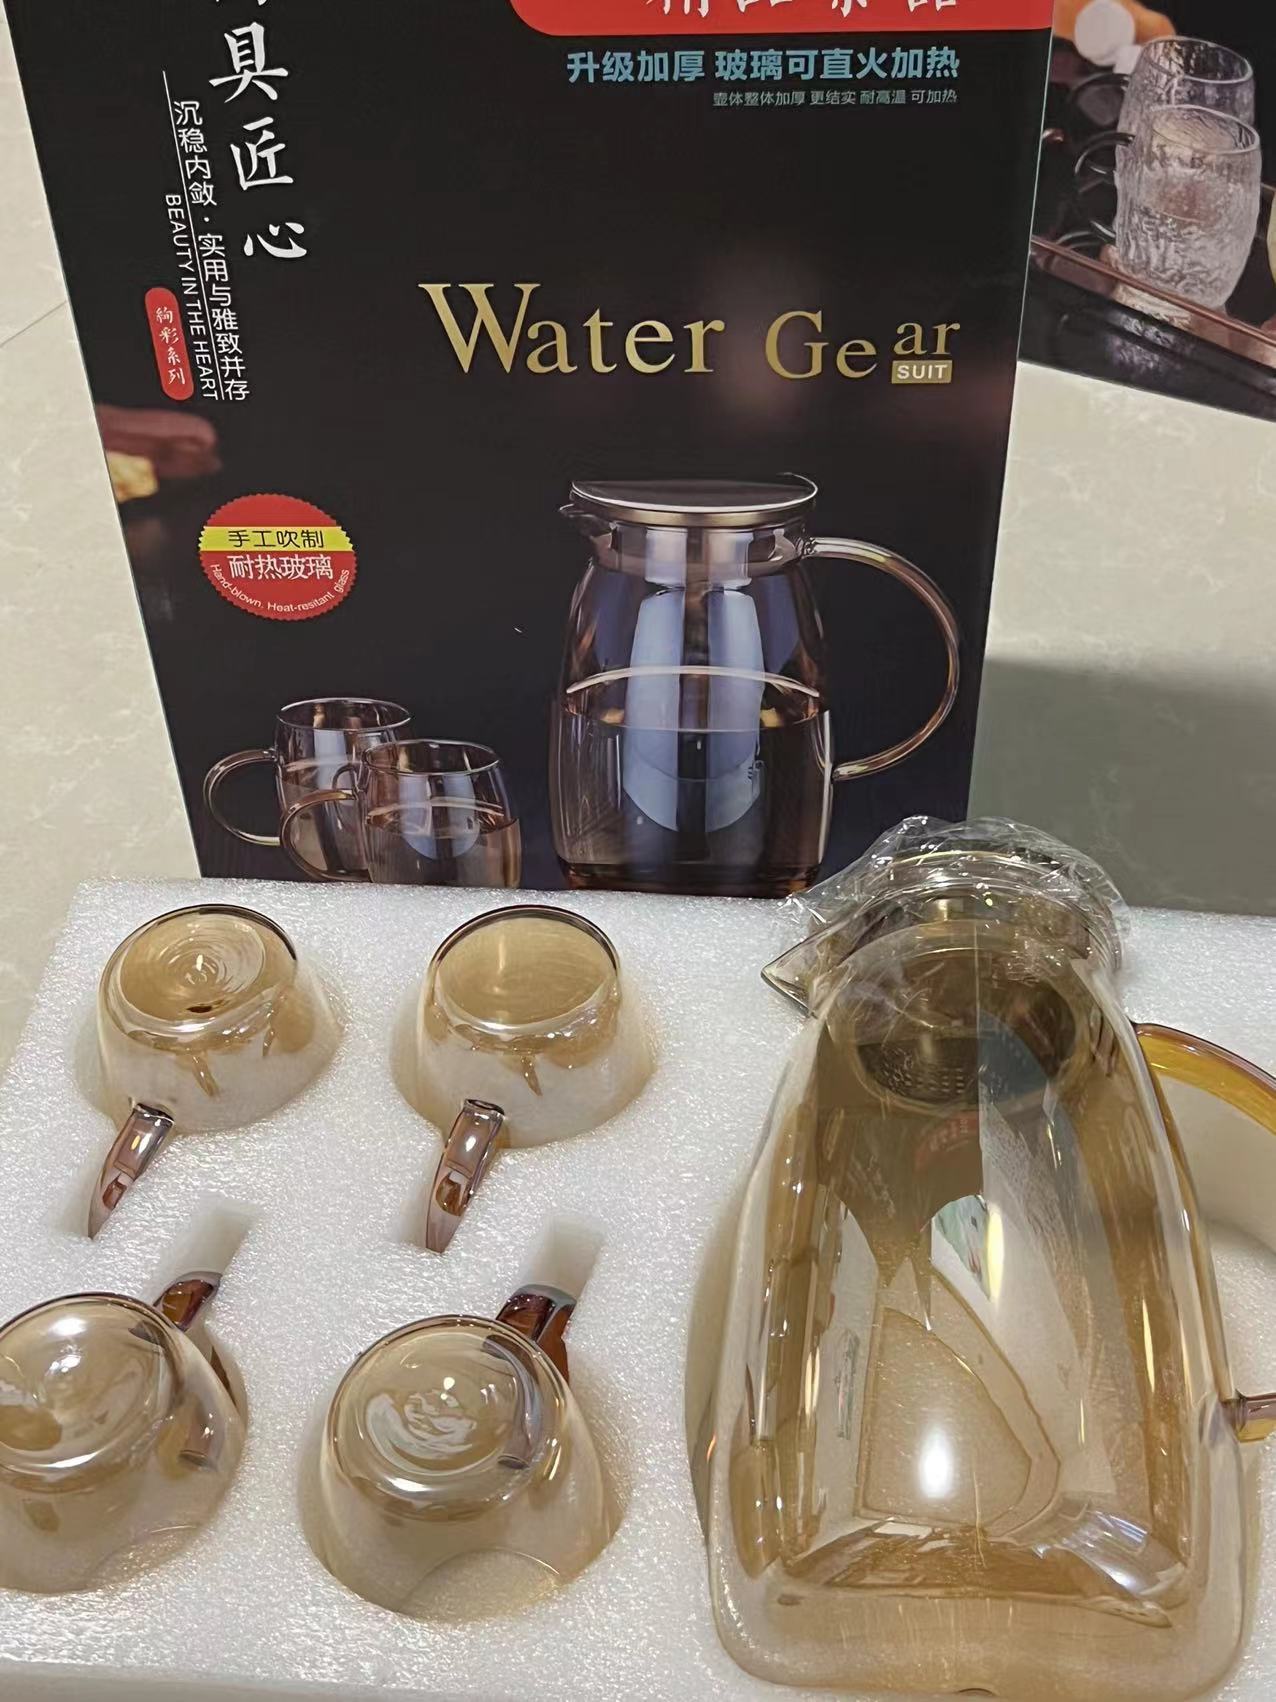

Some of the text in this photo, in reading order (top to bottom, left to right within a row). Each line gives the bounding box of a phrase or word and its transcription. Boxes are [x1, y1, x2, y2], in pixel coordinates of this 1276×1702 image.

[567, 45, 960, 83] 升级加厚 玻璃可直火加热
[809, 90, 857, 105] 更结实
[860, 89, 907, 105] 耐高温
[911, 88, 958, 103] 可加热
[209, 0, 308, 259] 具匠心
[165, 193, 219, 401] BEAUTY IN THE HEART
[418, 283, 725, 374] Water
[896, 363, 949, 380] SUIT
[227, 529, 325, 549] 手工吹制
[226, 553, 334, 581] 耐热玻璃
[333, 569, 350, 593] glass
